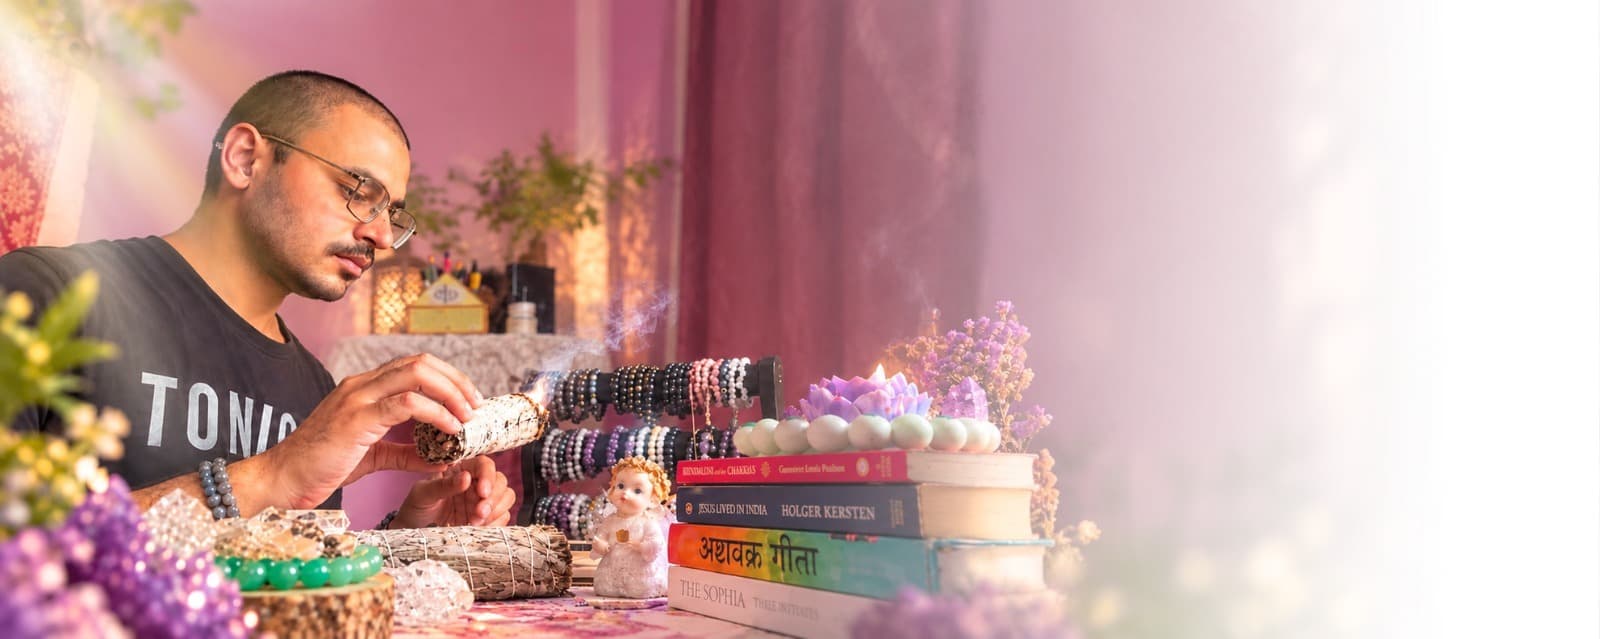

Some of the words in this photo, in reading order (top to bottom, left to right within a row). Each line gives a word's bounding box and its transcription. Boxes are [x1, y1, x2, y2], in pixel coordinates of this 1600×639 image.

[698, 503, 715, 514] JESUS
[716, 503, 735, 514] LIVED
[736, 503, 745, 514] IN
[745, 503, 768, 515] INDIA
[781, 504, 822, 518] HOLGER
[824, 505, 875, 520] KERSTEN
[770, 534, 819, 576] गीता
[680, 579, 701, 599] THE
[703, 583, 746, 608] SOPHIA
